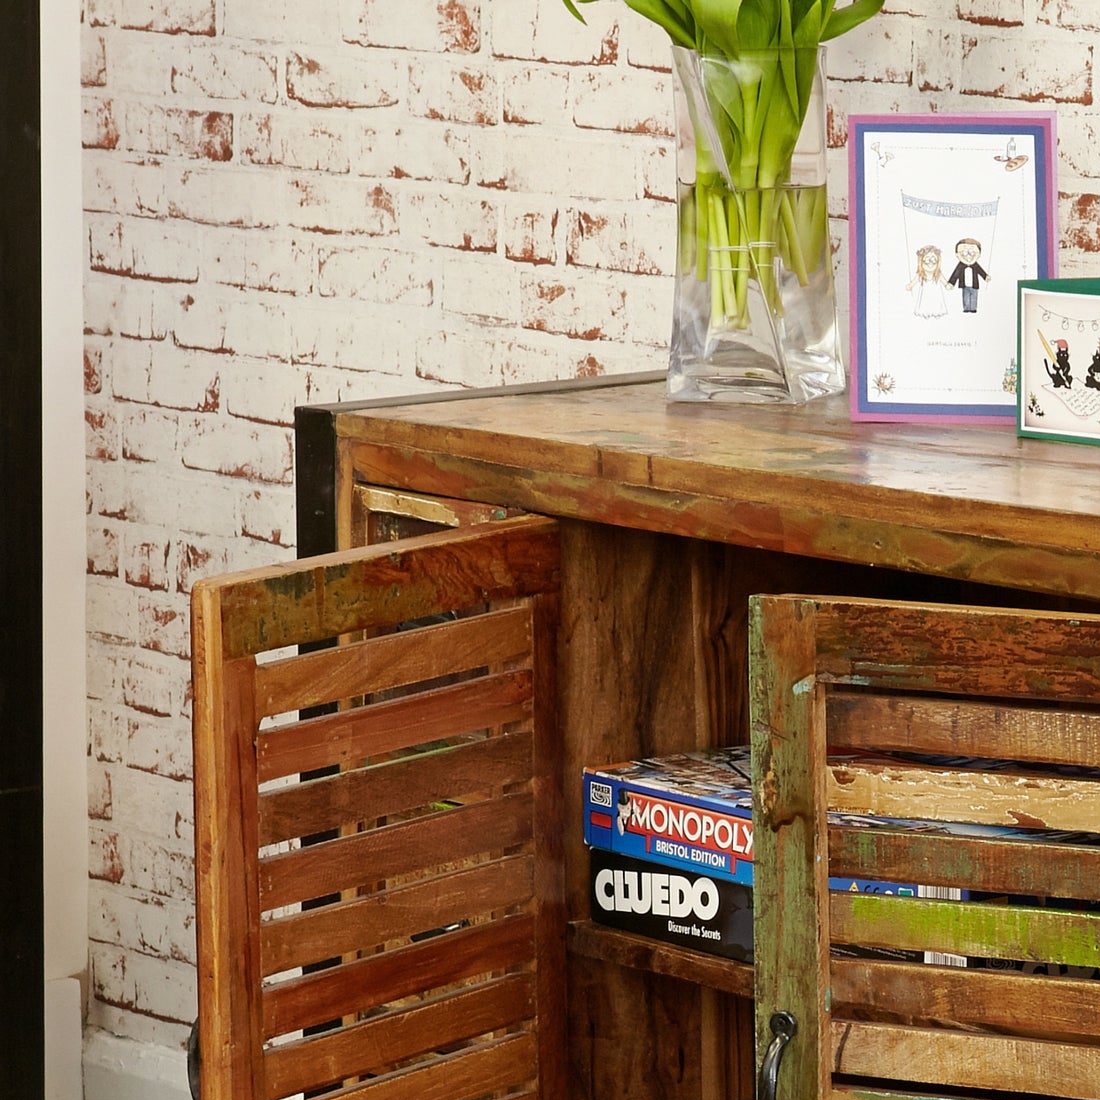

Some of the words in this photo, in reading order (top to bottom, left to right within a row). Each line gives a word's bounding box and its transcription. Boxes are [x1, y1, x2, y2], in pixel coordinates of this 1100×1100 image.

[591, 783, 611, 795] PARKER
[632, 798, 754, 855] MONOPOLY
[655, 840, 690, 859] BRISTOL
[691, 848, 725, 867] EDITION
[595, 869, 720, 920] CLUEDO
[668, 920, 691, 935] Discover
[691, 924, 701, 937] the
[701, 926, 721, 941] Secrets
